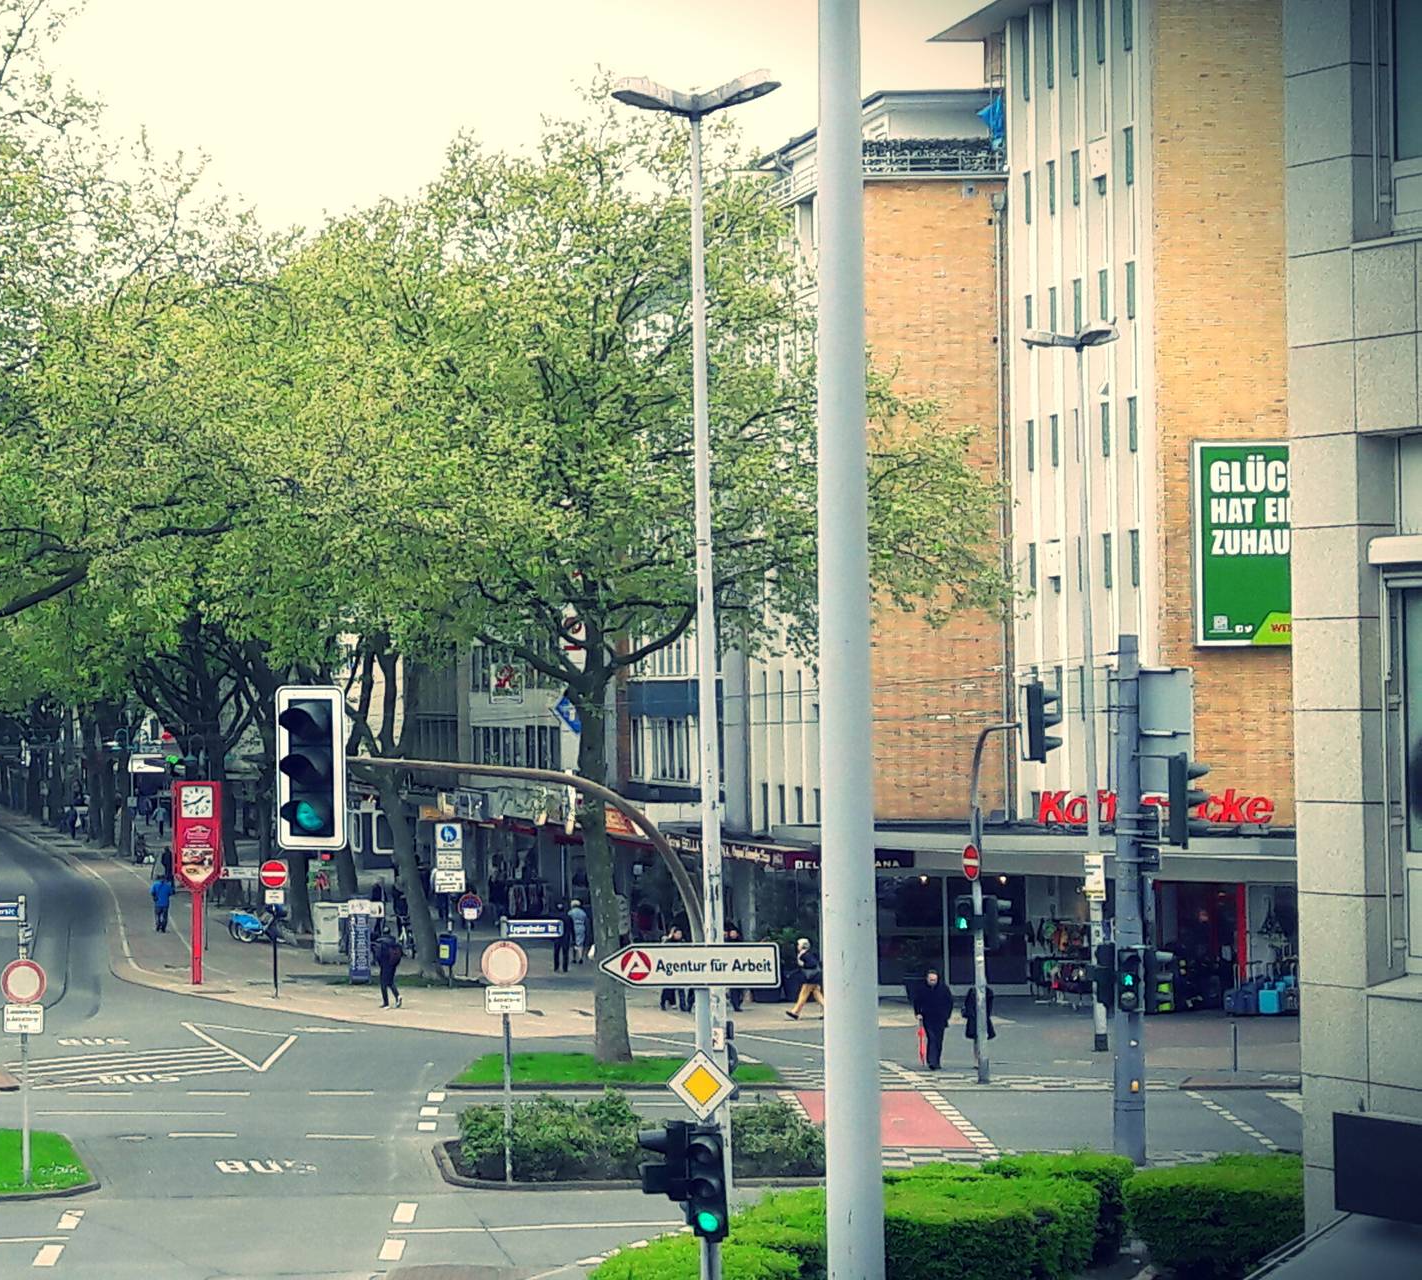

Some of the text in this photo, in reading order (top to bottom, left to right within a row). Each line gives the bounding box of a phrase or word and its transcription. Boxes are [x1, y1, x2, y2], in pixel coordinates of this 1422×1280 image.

[1210, 455, 1291, 493] GLÜC
[1210, 497, 1257, 524] HAT
[655, 958, 772, 976] Agentur für Arbeit
[98, 1073, 180, 1085] BUS
[214, 1159, 318, 1174] BUS
